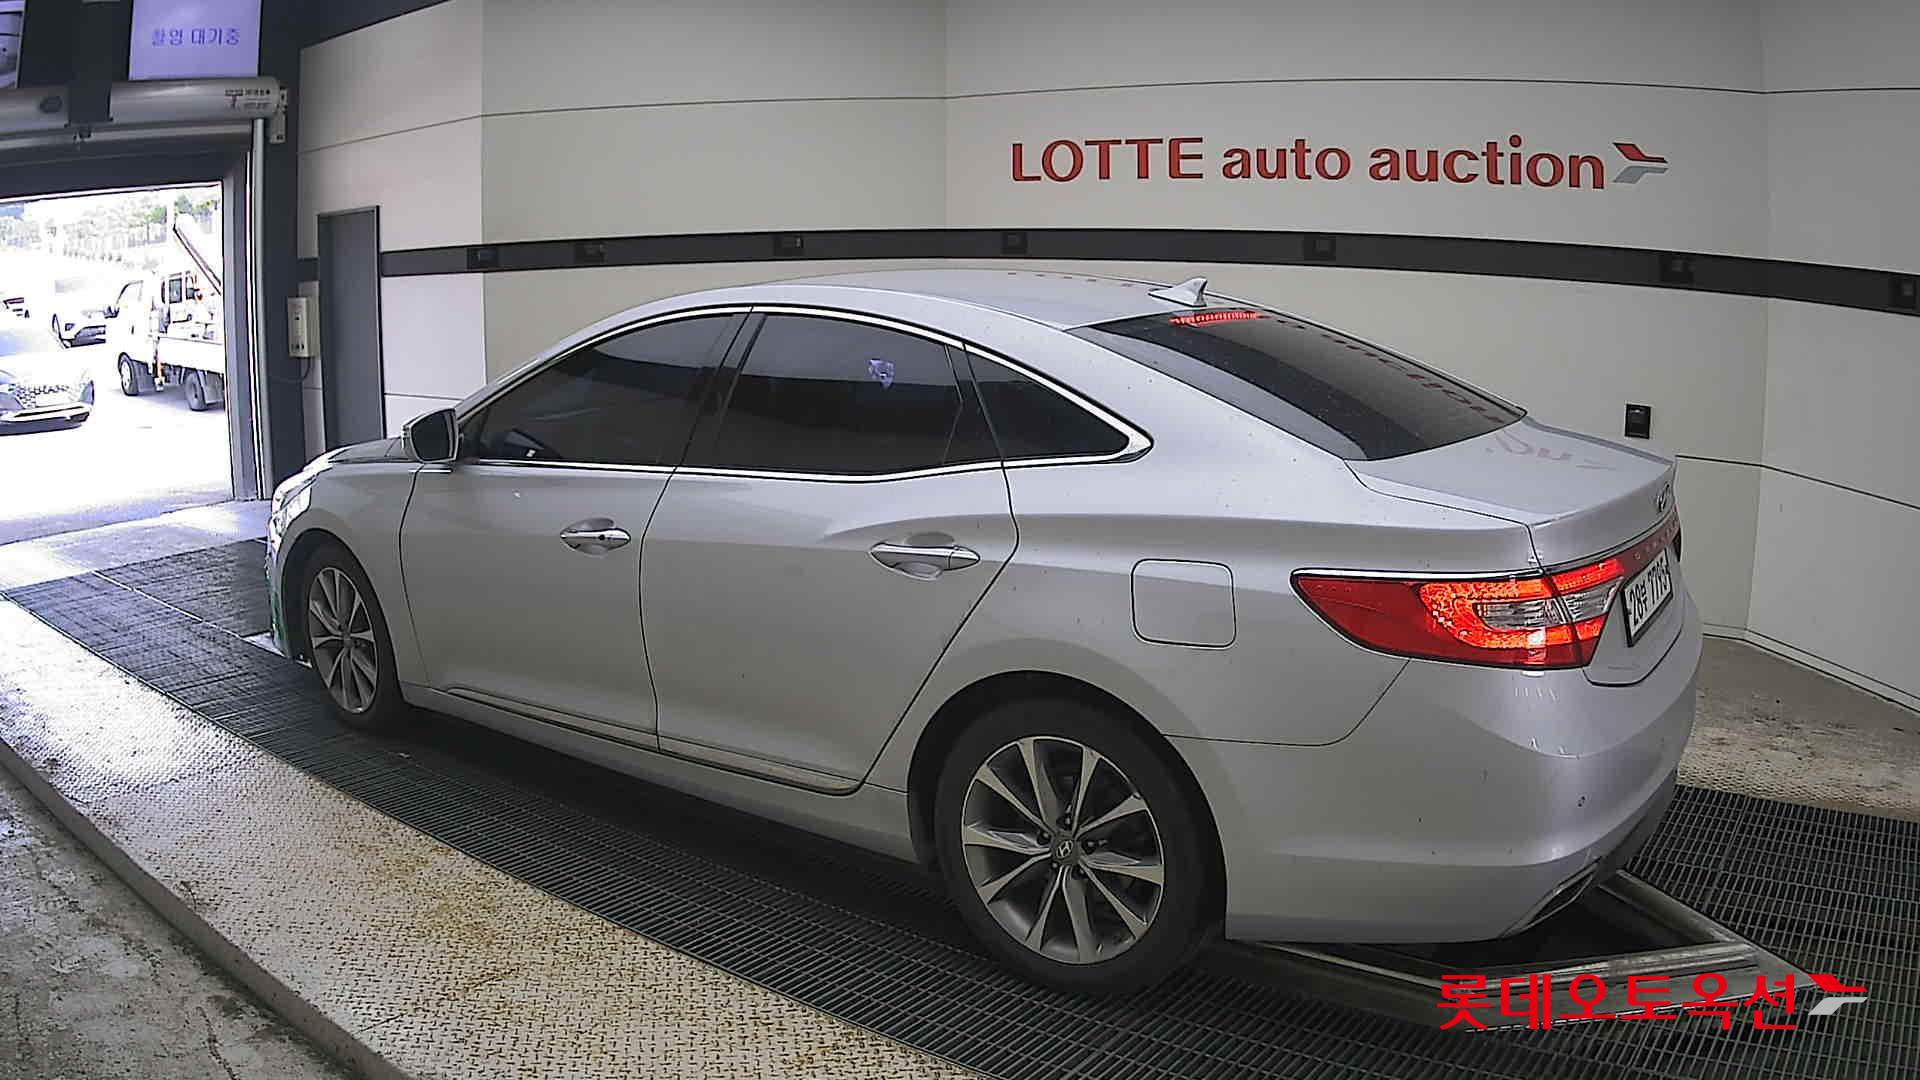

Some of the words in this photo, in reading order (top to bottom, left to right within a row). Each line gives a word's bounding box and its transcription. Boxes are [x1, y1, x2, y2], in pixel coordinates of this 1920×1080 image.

[191, 27, 240, 46] 대기중
[1012, 138, 1203, 182] LOTTE
[1222, 139, 1351, 181] auto
[1369, 135, 1605, 189] auction
